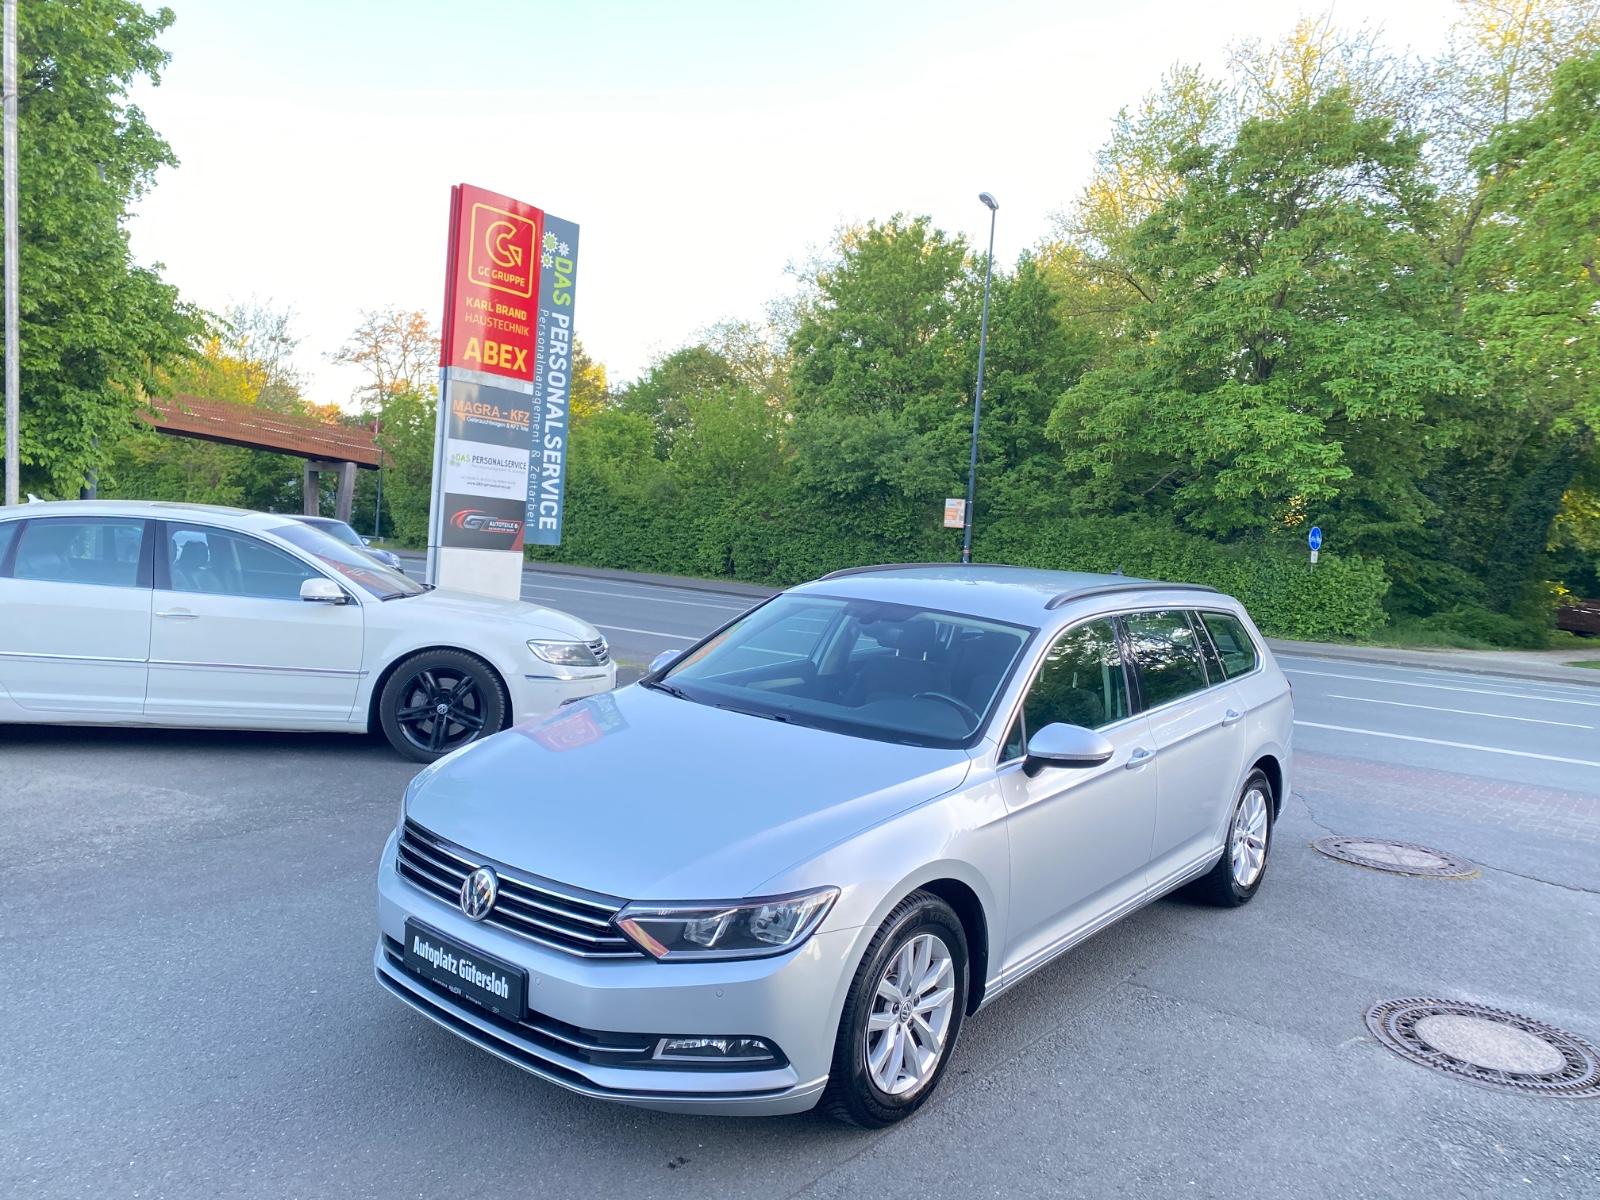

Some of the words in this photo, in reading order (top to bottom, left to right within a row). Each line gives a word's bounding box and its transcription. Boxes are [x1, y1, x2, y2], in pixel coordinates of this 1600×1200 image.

[478, 265, 491, 277] GC
[491, 269, 525, 287] GRUPPE
[552, 255, 574, 307] DAS
[464, 311, 530, 337] HAUSTECHNIK
[465, 296, 494, 312] KARL
[495, 303, 527, 321] BRAND
[463, 336, 528, 373] ABEX
[531, 308, 549, 443] Personalmanagement
[453, 399, 500, 418] MAGRA
[510, 408, 530, 423] KFZ
[538, 312, 570, 530] PERSONALSERVICE
[455, 453, 471, 463] DAS
[472, 455, 527, 470] PERSONALSERVICE
[531, 449, 541, 458] &
[526, 465, 540, 528] Zeitarbeit
[413, 935, 458, 975] Autoplatz
[458, 957, 509, 1000] Gütersloh
